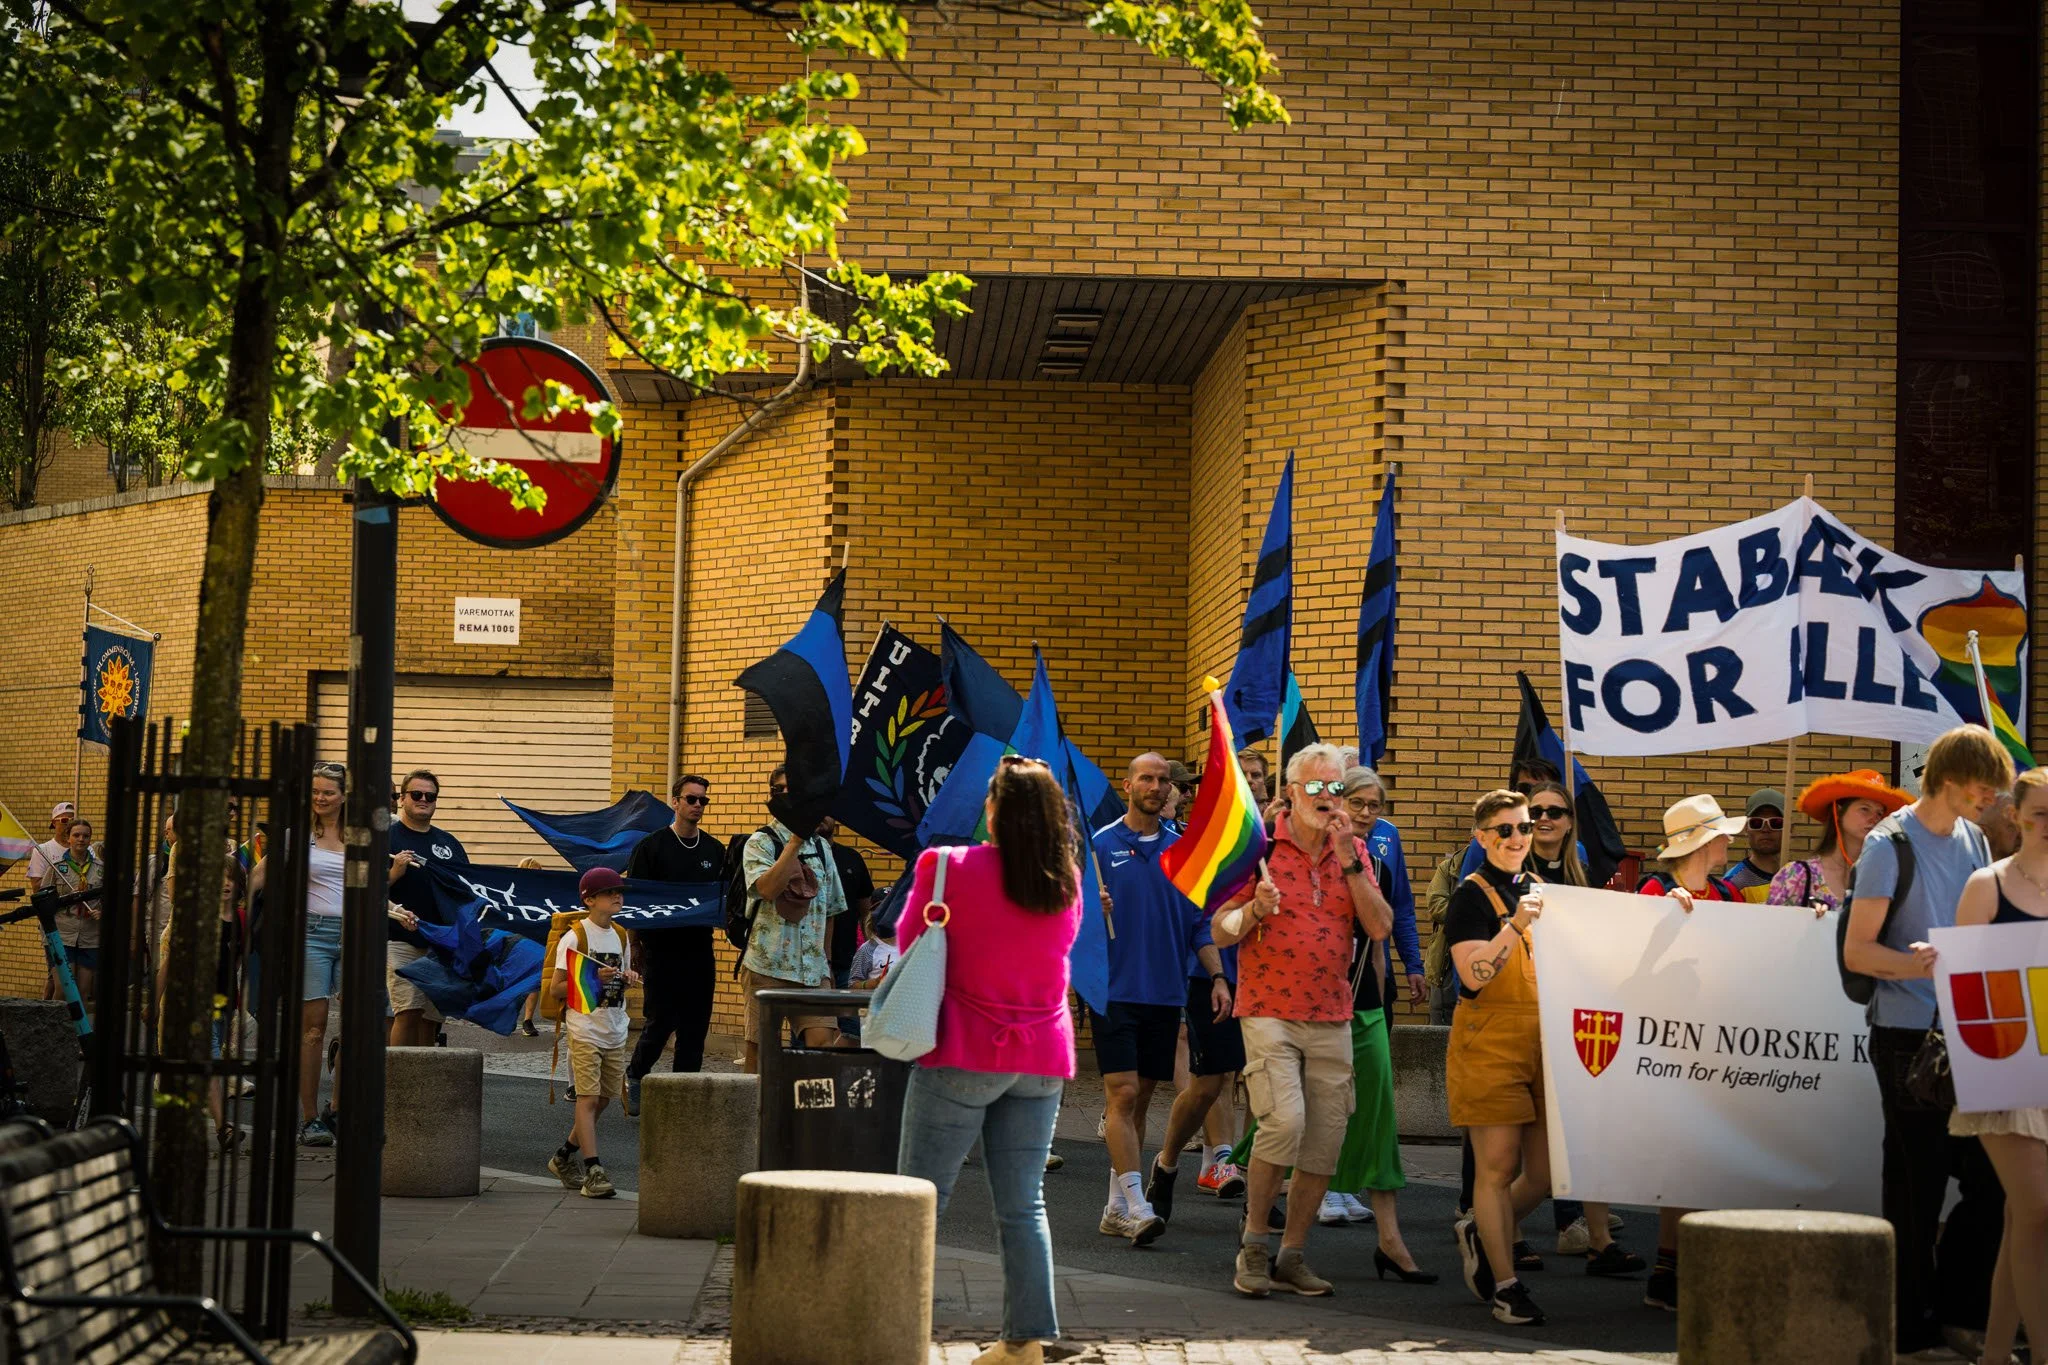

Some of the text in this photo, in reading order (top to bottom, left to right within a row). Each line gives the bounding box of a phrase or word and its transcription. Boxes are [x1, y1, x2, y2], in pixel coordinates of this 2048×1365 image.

[458, 608, 515, 617] VAREMOTTAK
[459, 623, 515, 633] REMA 1000
[1564, 646, 1758, 733] FOR
[1636, 1016, 1706, 1051] DEN
[1715, 1025, 1839, 1063] NORSKE
[1636, 1056, 1821, 1093] Rom for kjærlighet
